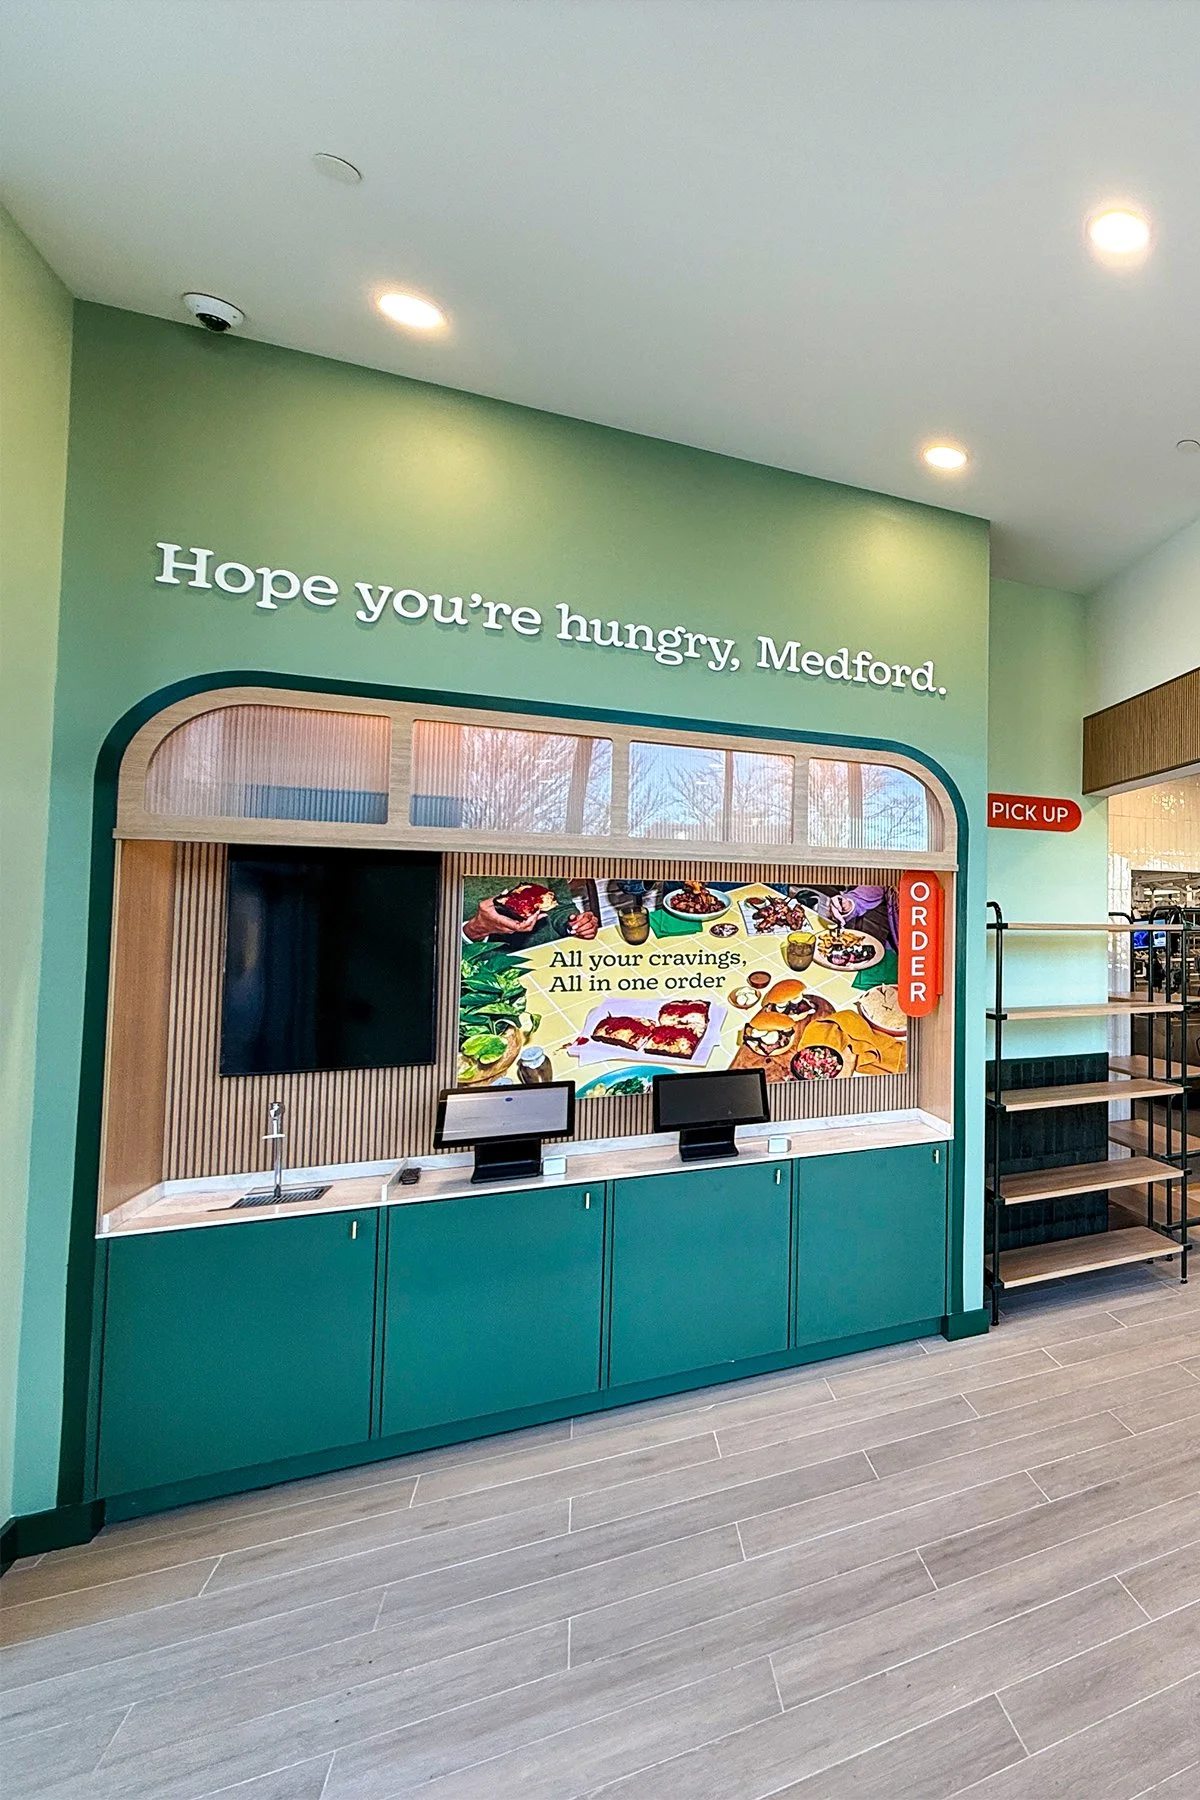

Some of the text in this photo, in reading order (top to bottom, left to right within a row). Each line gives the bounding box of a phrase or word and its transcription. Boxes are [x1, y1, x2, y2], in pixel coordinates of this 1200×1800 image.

[155, 542, 947, 695] Hope you’re hungry, Medford.
[992, 802, 1069, 823] PICK UP
[910, 881, 930, 1002] ORDER
[549, 950, 747, 971] All your cravings,
[549, 972, 726, 992] All in one order
